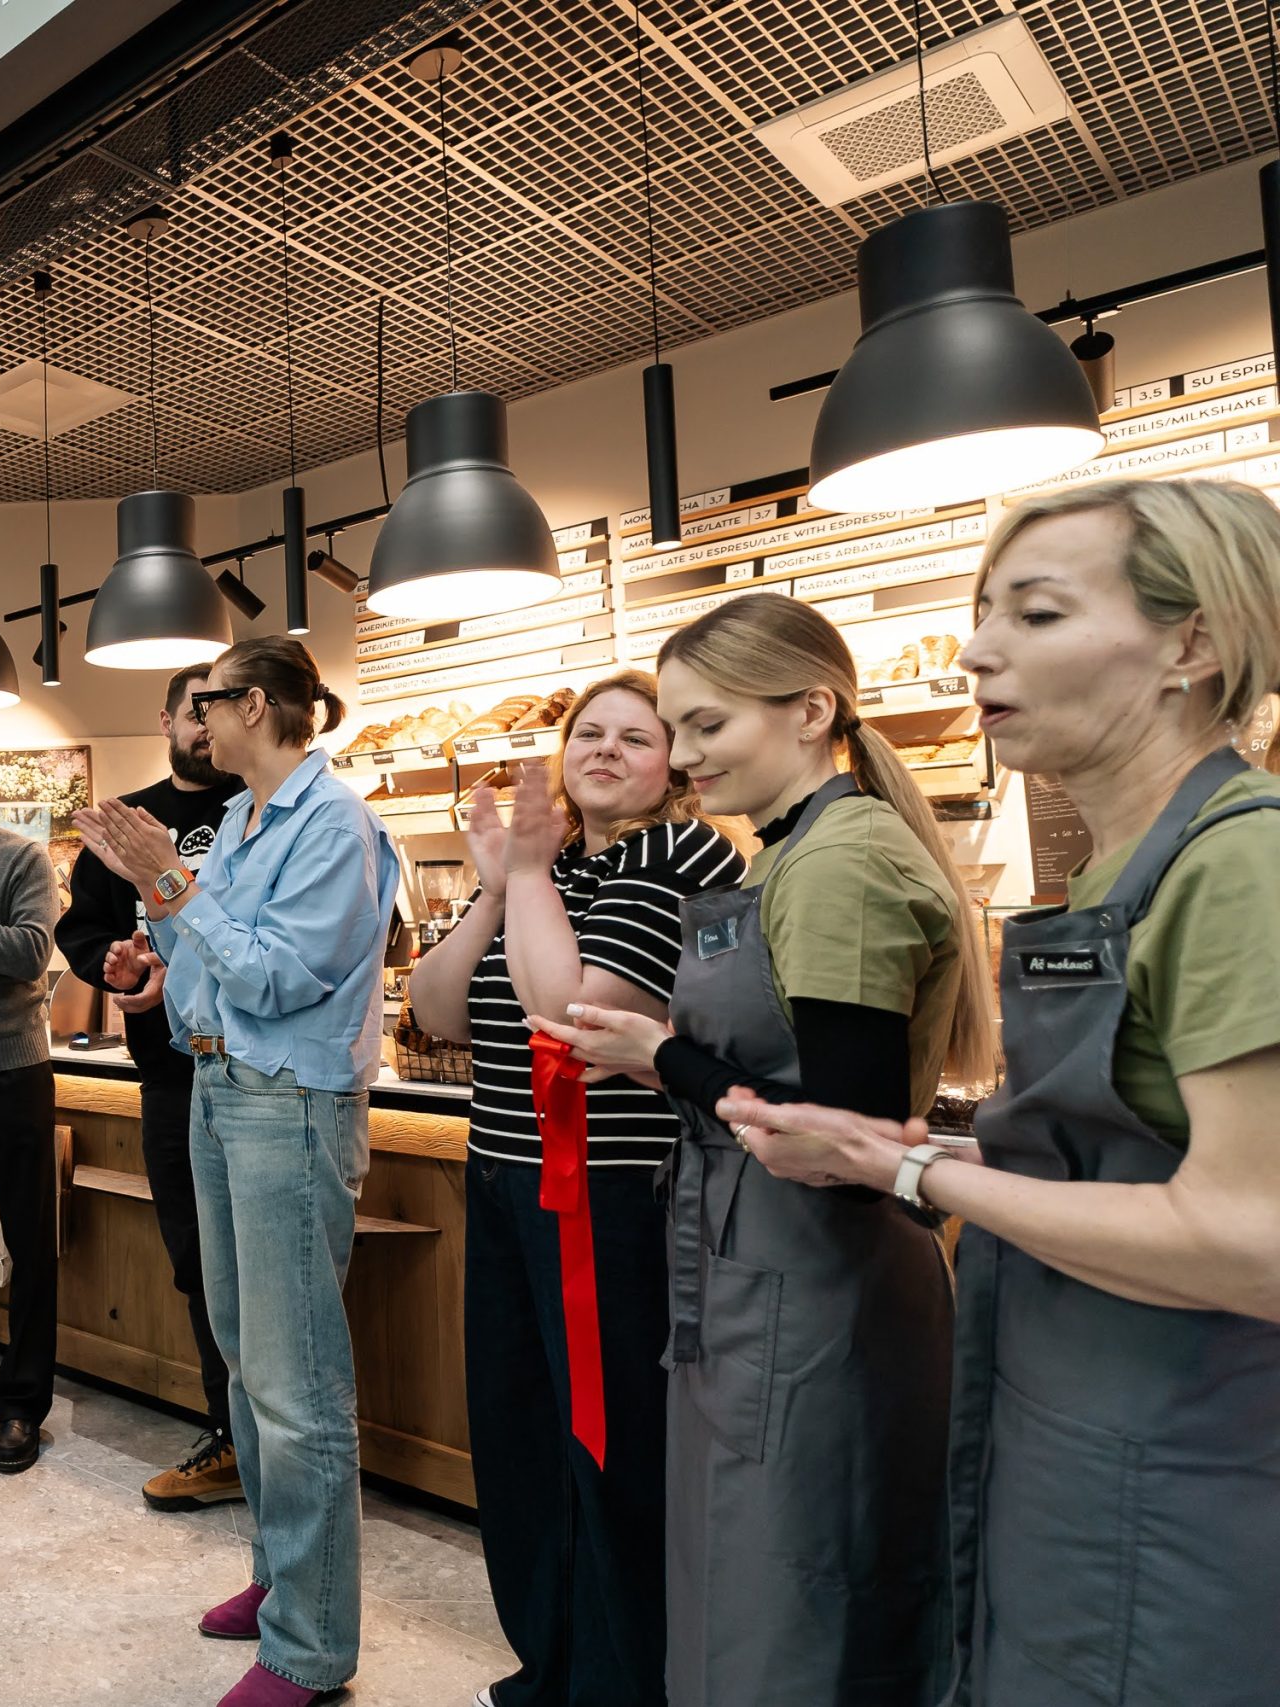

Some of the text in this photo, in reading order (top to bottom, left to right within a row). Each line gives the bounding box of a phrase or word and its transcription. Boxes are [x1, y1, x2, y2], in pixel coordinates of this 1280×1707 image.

[1192, 376, 1215, 388] SU
[1120, 440, 1215, 470] LEMONADE
[681, 516, 742, 538] ATE/LATTE
[661, 554, 686, 567] LATE
[689, 551, 704, 562] SU
[706, 531, 790, 559] ESPRESU/LATE
[794, 524, 826, 539] WITH
[830, 510, 897, 532] ESPRESSO
[835, 534, 916, 558] ARBATA/JAM
[921, 529, 946, 542] TEA
[662, 600, 717, 618] LATE/ICED
[360, 639, 402, 655] LATE/LATTE
[360, 659, 411, 676] KARAMELINIS
